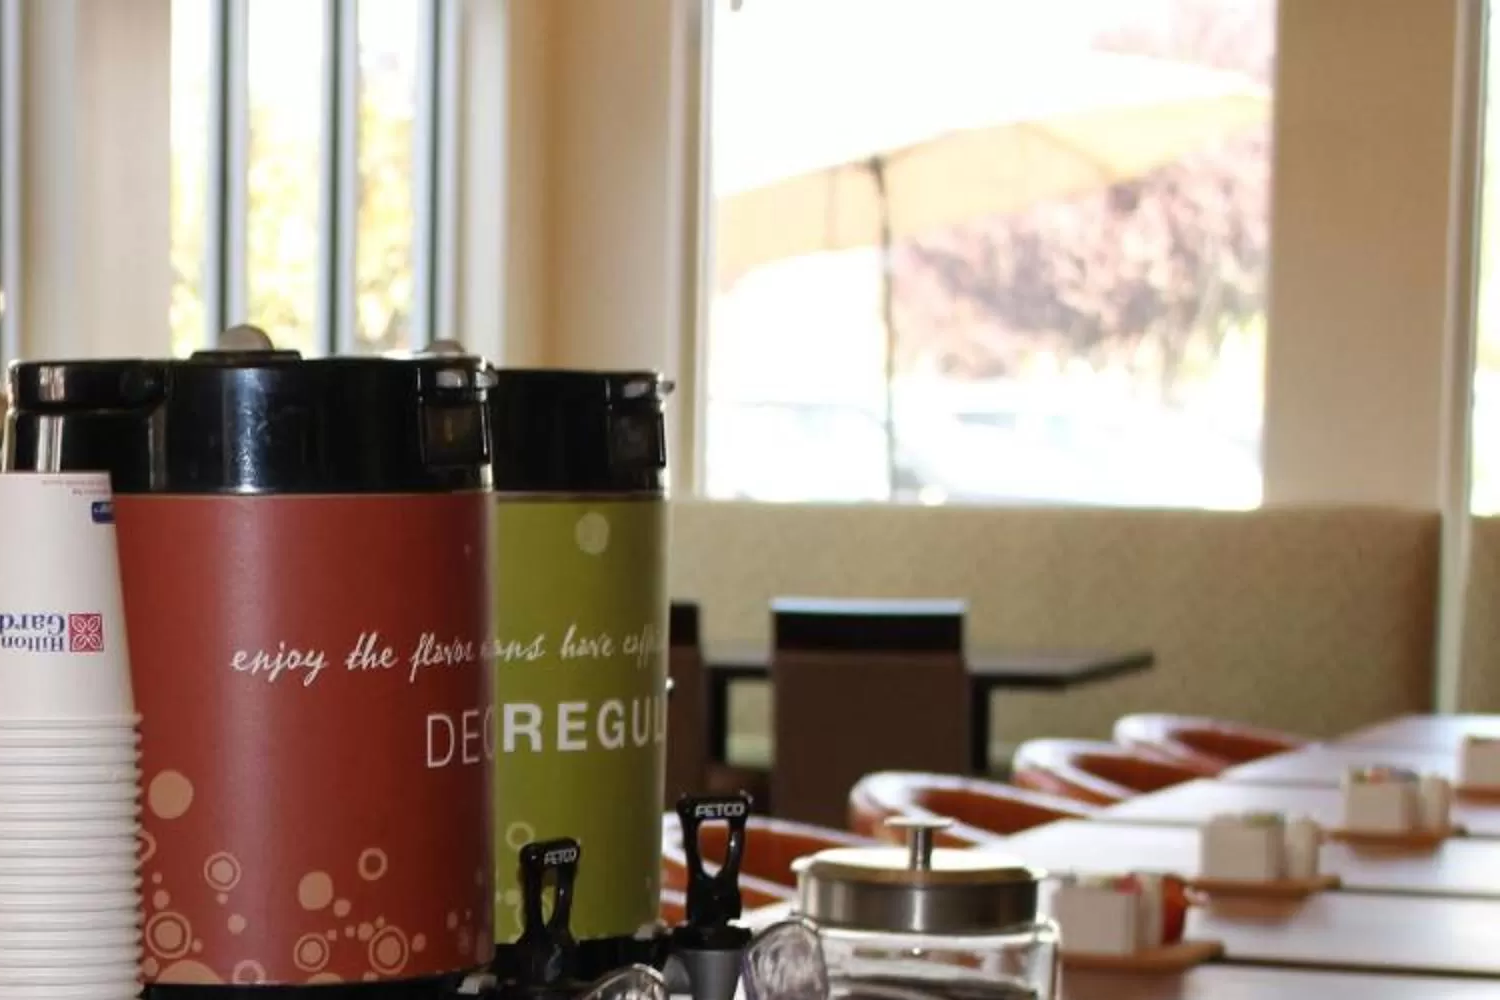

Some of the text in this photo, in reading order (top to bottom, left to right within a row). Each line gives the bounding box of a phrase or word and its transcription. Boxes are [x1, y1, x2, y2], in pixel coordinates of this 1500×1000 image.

[0, 635, 64, 653] Hilton
[230, 630, 475, 688] enjoy the flavor
[560, 622, 614, 660] have
